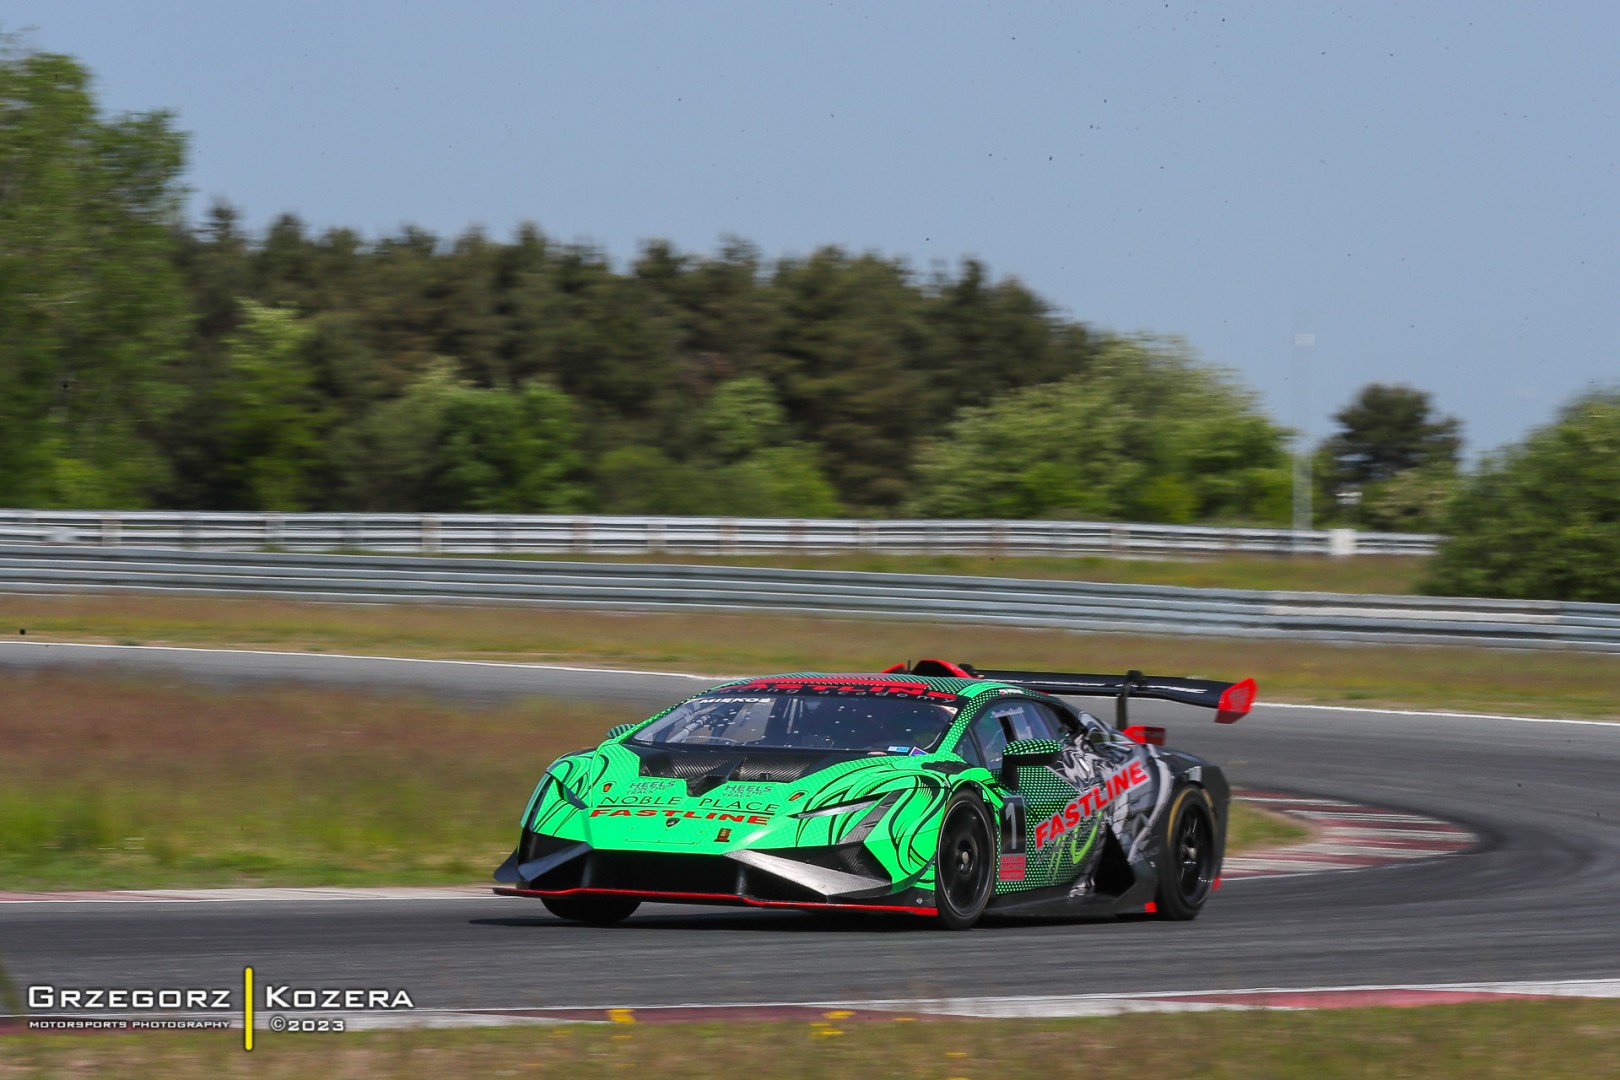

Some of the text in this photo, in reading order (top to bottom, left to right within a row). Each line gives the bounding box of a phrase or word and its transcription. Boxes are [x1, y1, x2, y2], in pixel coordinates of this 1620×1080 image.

[725, 784, 772, 793] HEELS
[599, 795, 780, 812] NOBLE PLACE
[1034, 760, 1149, 849] FASTLINE
[589, 809, 771, 826] FASTLINE
[1005, 802, 1018, 850] 1
